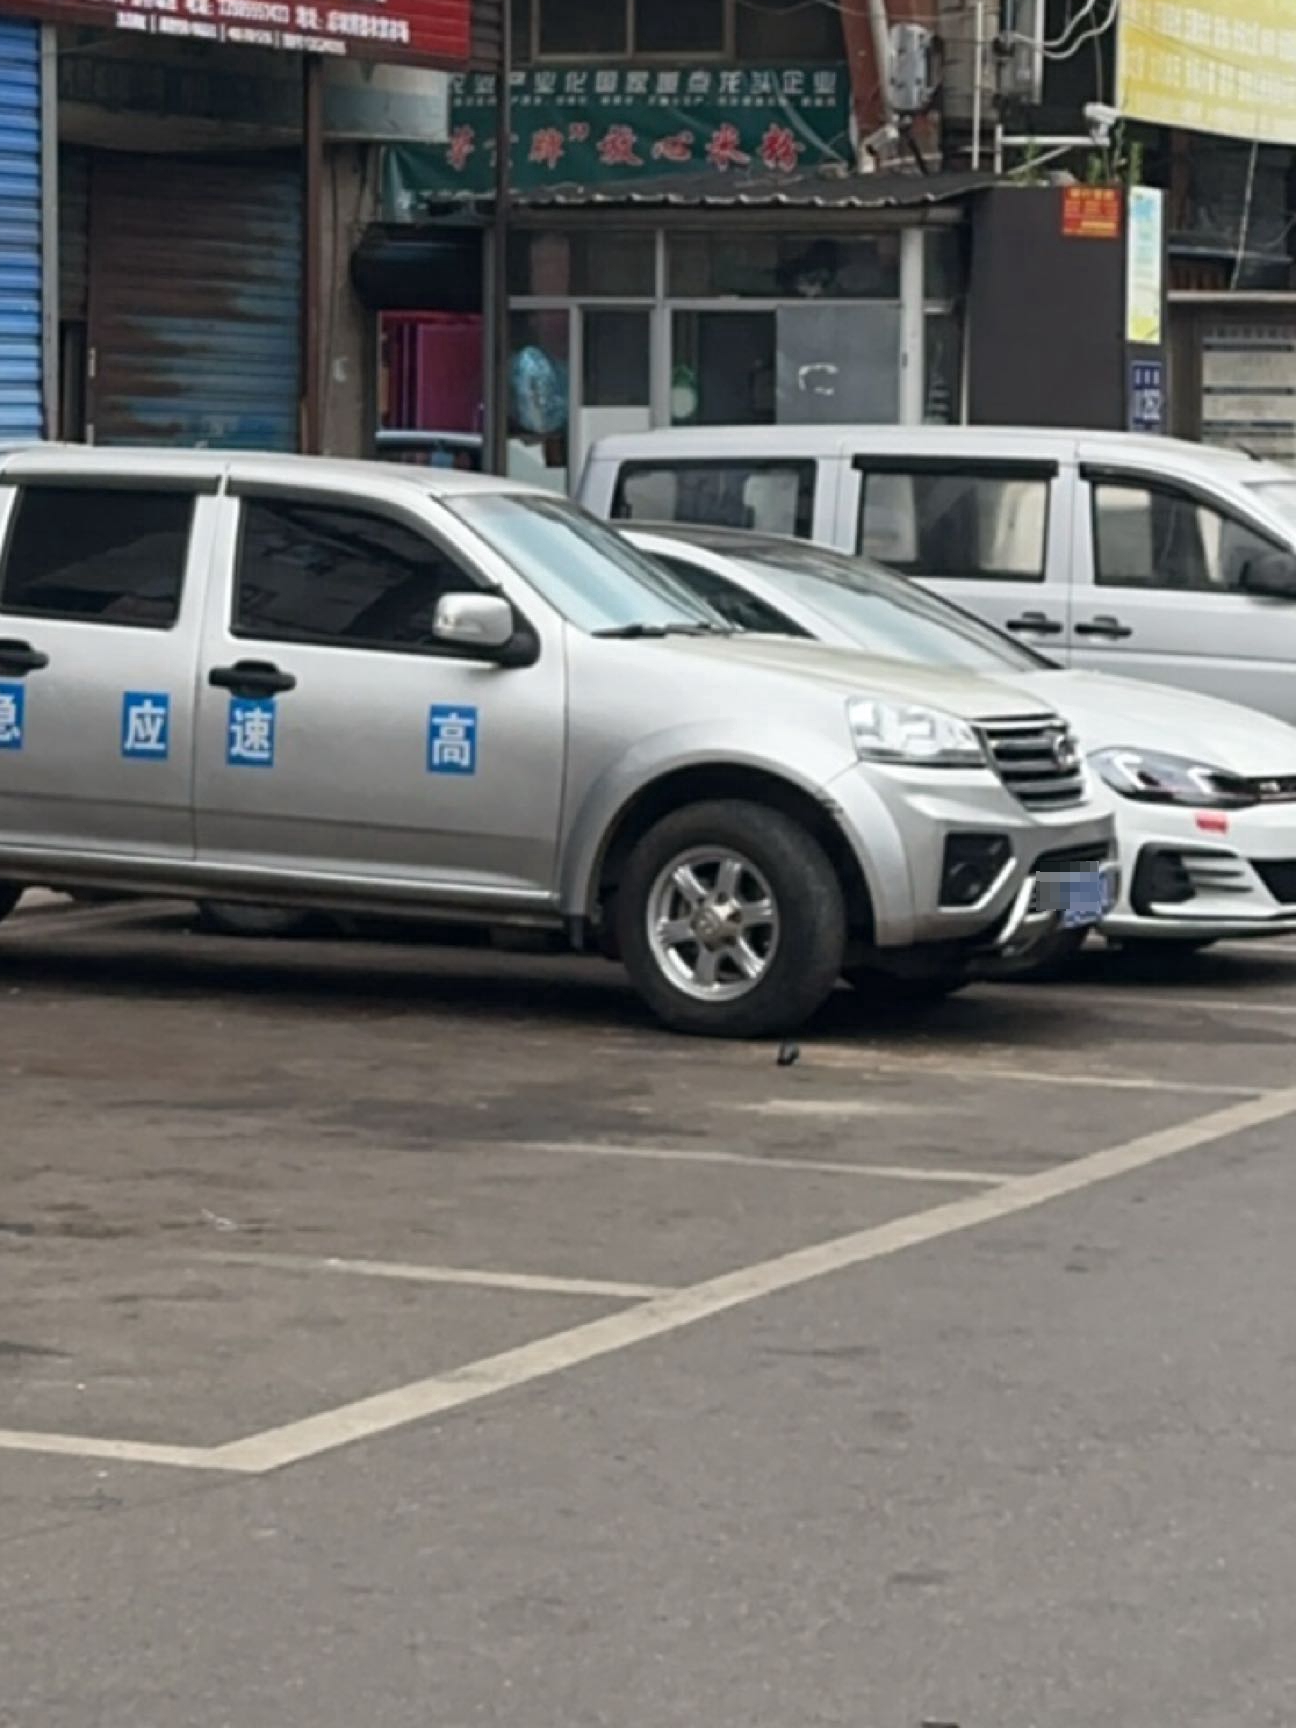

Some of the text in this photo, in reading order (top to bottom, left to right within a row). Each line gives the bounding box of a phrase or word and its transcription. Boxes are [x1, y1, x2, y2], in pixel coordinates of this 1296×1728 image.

[124, 699, 167, 752] 应
[228, 707, 273, 760] 速
[431, 712, 474, 769] 高
